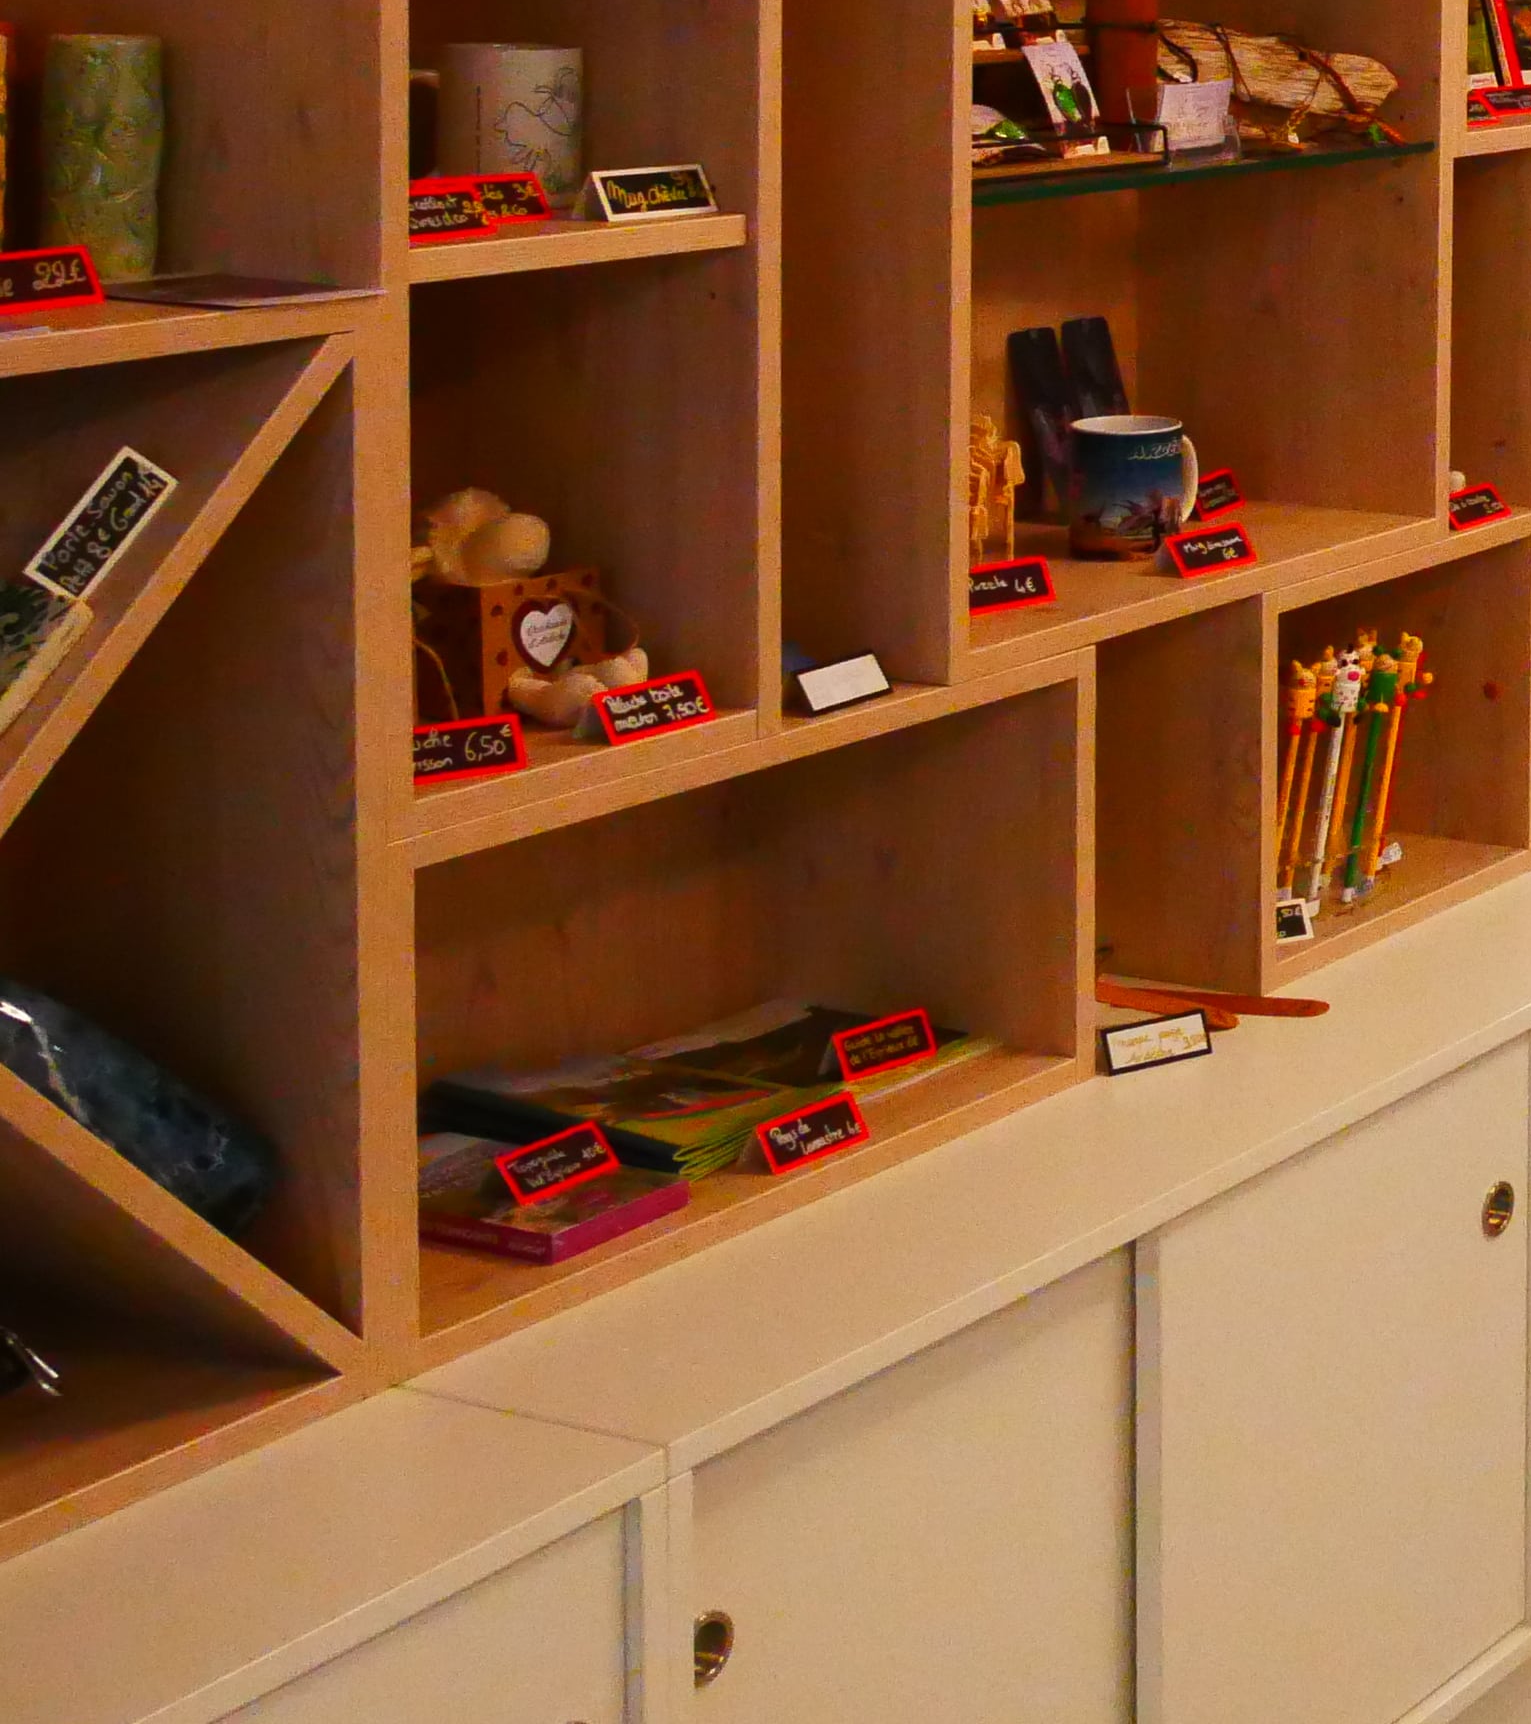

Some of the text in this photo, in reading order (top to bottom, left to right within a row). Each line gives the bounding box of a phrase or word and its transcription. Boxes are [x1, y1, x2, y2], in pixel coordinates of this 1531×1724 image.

[607, 179, 648, 212] Mug
[1014, 577, 1036, 593] 4€
[412, 727, 453, 751] uche
